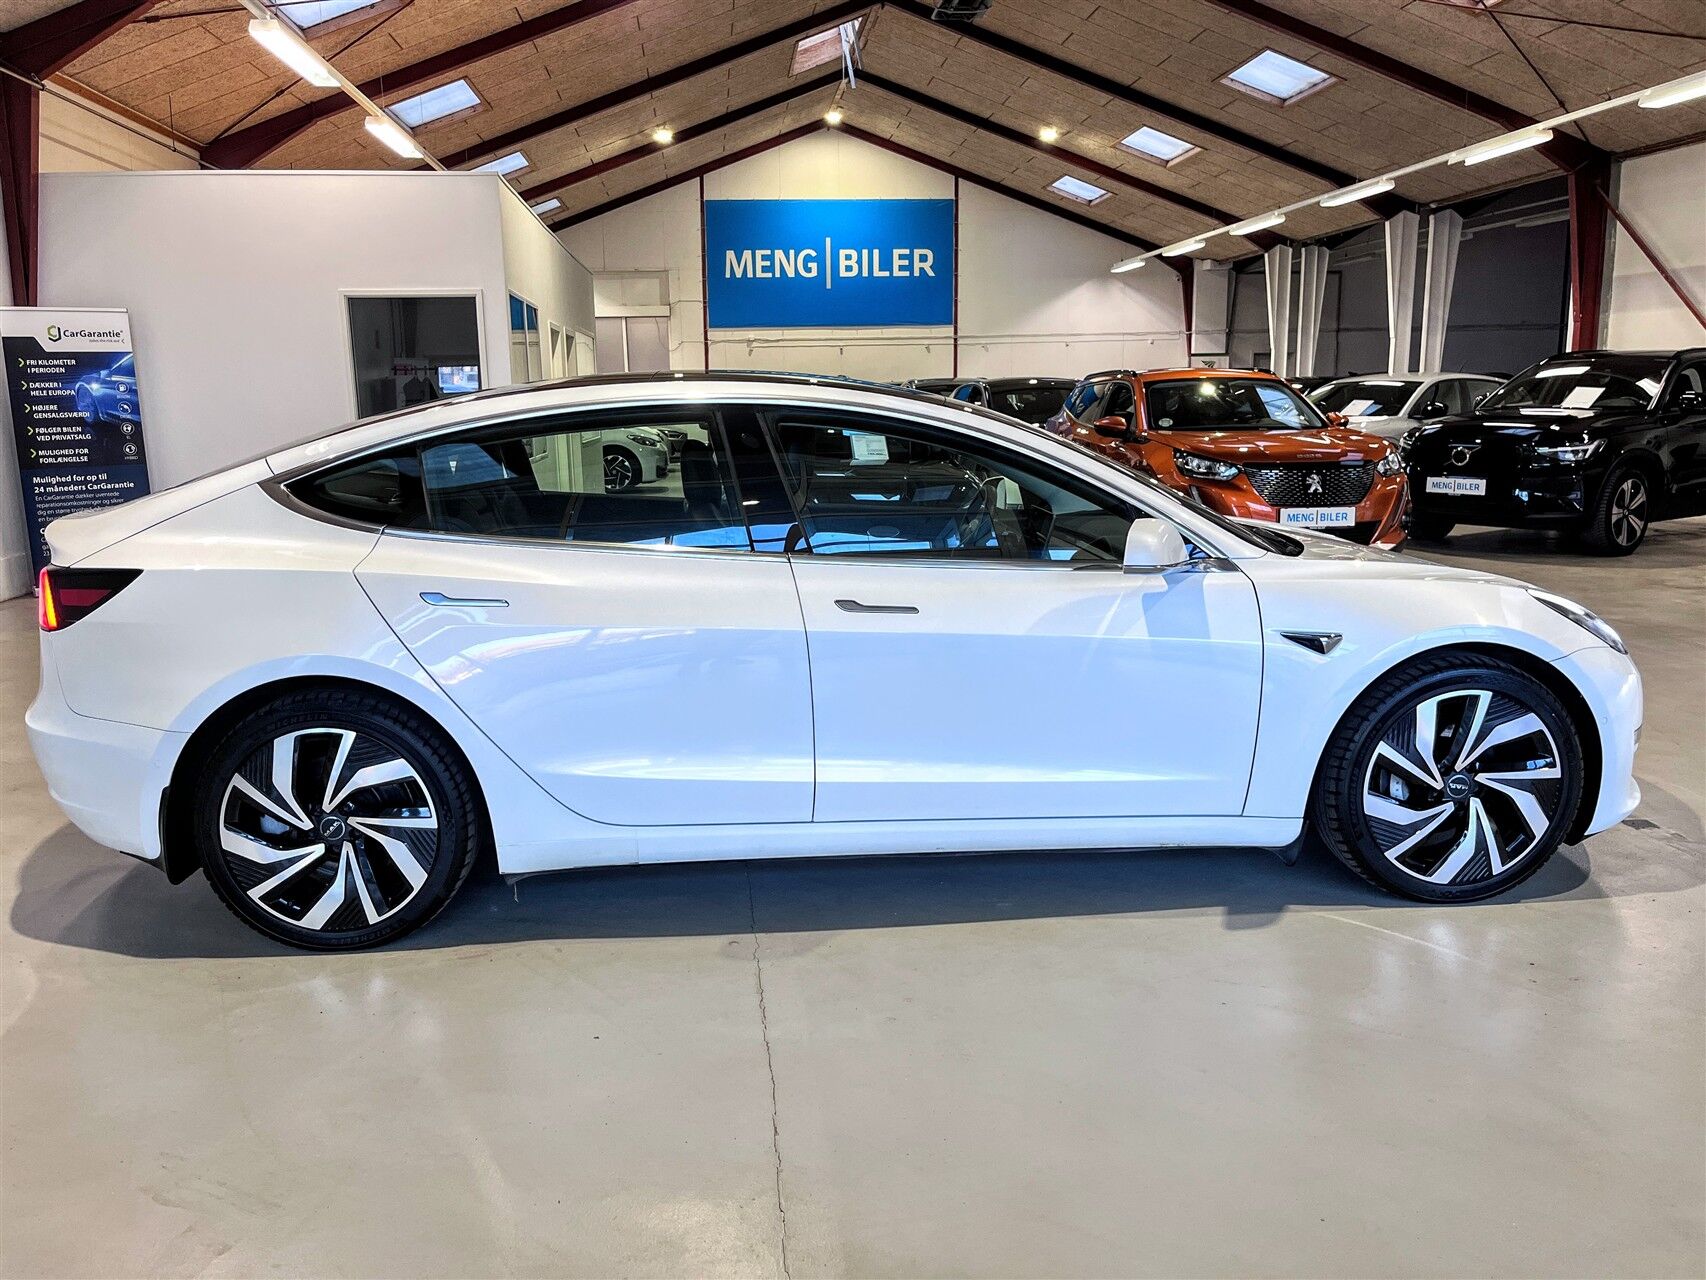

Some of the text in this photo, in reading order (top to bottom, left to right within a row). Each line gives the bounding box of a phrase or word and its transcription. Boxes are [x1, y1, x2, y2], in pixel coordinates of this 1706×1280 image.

[725, 248, 936, 278] MENG BILER
[33, 411, 90, 419] GENSALGSVÆRDI
[51, 433, 91, 441] PRIVATSALG
[39, 456, 88, 464] FORLÆNGELSE
[32, 475, 72, 484] Mulighed
[72, 474, 85, 482] for
[86, 474, 97, 482] op
[46, 483, 86, 493] måneders
[87, 481, 134, 490] CarGarantie
[1432, 481, 1480, 491] MENG BILER
[1286, 512, 1348, 522] MENG BILER
